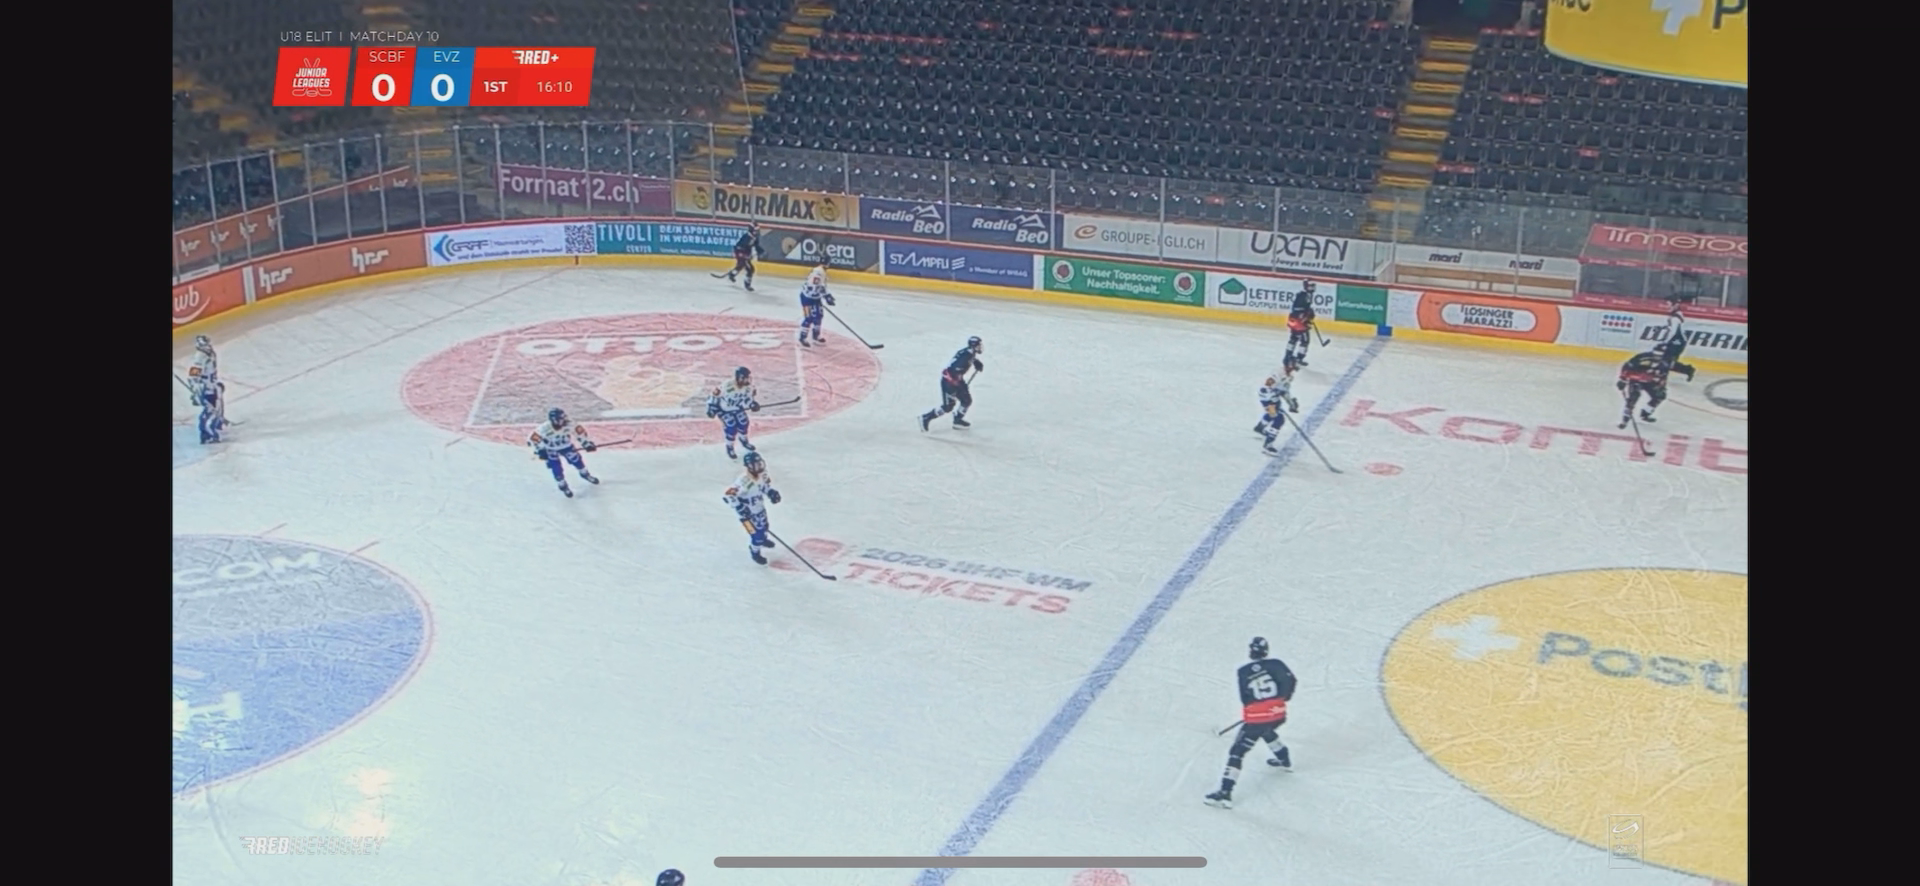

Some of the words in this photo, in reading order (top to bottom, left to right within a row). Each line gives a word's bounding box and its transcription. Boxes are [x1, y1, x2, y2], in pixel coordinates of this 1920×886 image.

[871, 208, 914, 222] Radio
[598, 224, 652, 242] TIVOLI
[912, 219, 945, 235] BeO
[972, 217, 1017, 232] Radio
[659, 234, 671, 243] IN
[1015, 229, 1049, 244] BeO
[1250, 231, 1348, 261] UXAN
[351, 247, 389, 273] hrs
[1429, 252, 1462, 264] marti
[259, 266, 293, 293] hrs
[1082, 266, 1111, 278] Unser
[1113, 269, 1167, 284] Topscorer:
[1249, 288, 1334, 307] LETTEROP
[1464, 306, 1514, 319] LOSINGER
[1463, 316, 1513, 328] MARAZZI
[516, 333, 782, 355] OTTO'S
[861, 548, 947, 570] 2026
[845, 562, 1071, 614] TICKETS
[1248, 674, 1278, 700] 15
